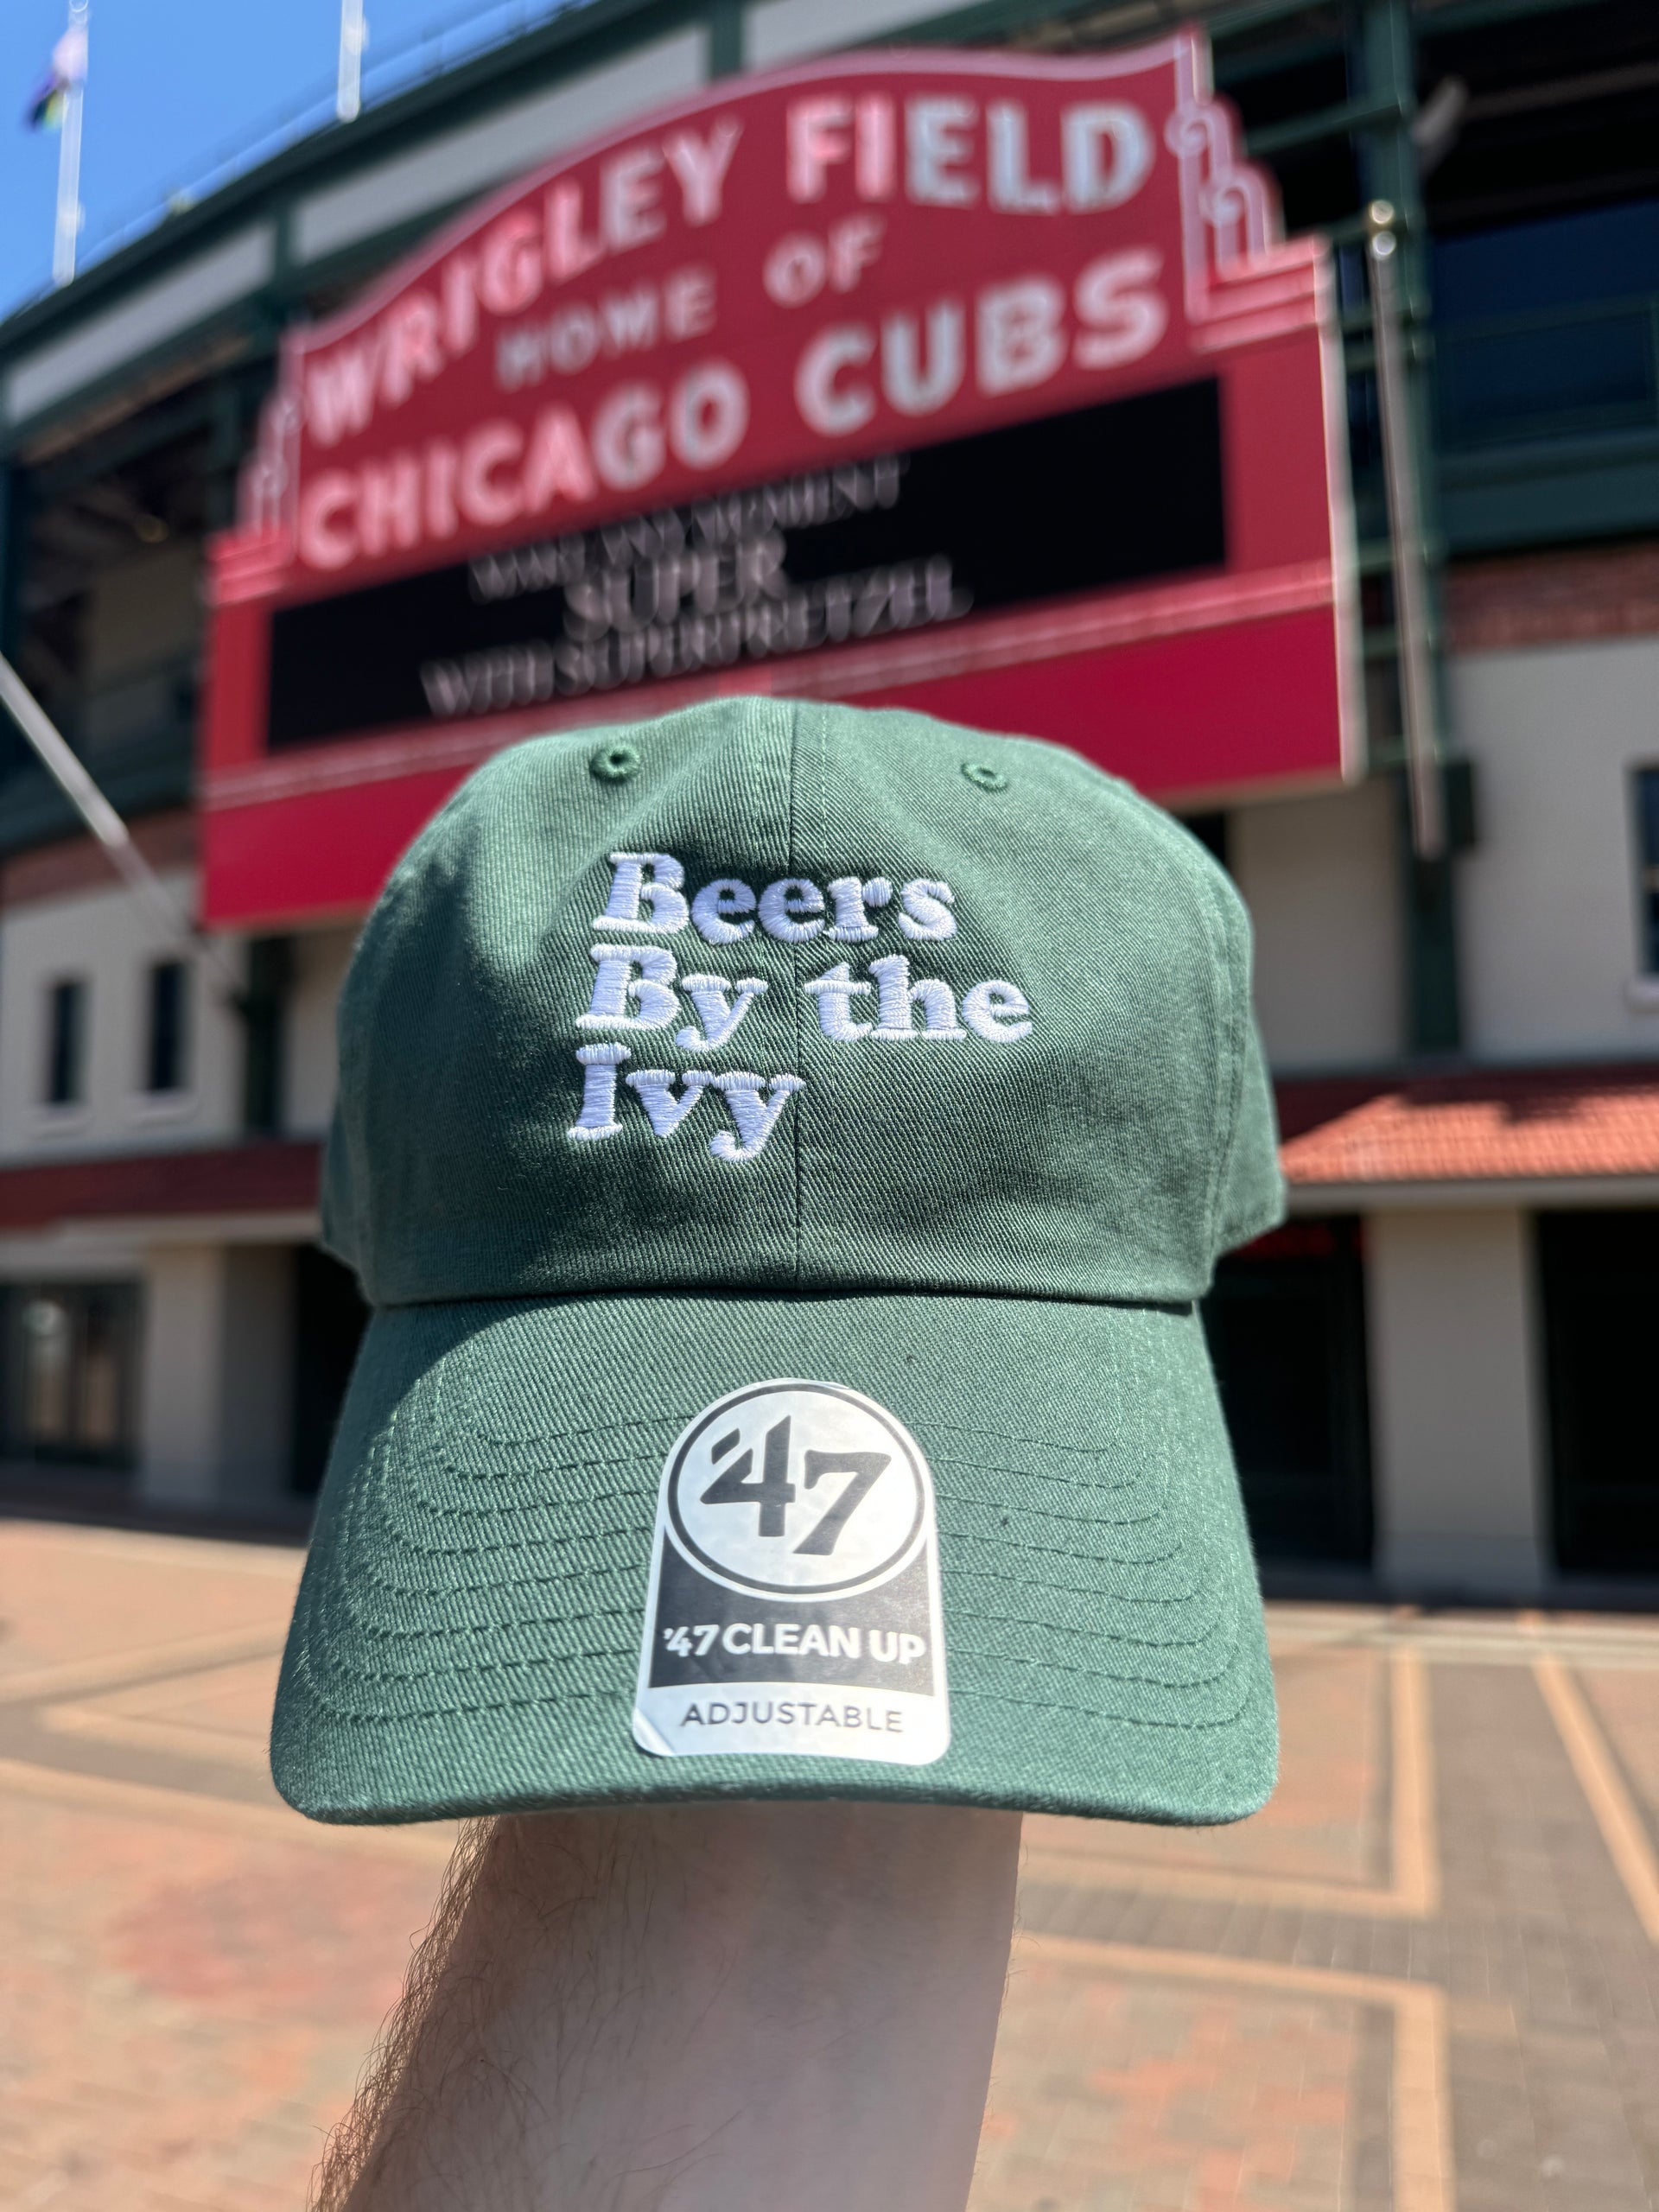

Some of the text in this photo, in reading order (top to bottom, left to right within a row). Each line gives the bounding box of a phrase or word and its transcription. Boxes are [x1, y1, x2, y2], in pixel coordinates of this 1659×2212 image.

[303, 93, 1156, 448] WRIGLEY FIELD
[494, 213, 885, 393] HOME OF
[296, 246, 1168, 570] CHICAGO CUBS
[563, 525, 788, 641] SUPER
[592, 851, 957, 946] Beers
[575, 942, 1033, 1053] By the
[568, 1042, 805, 1163] Ivy
[663, 1623, 927, 1665] '47 CLEAN UP
[680, 1700, 904, 1732] ADJUSTABLE
